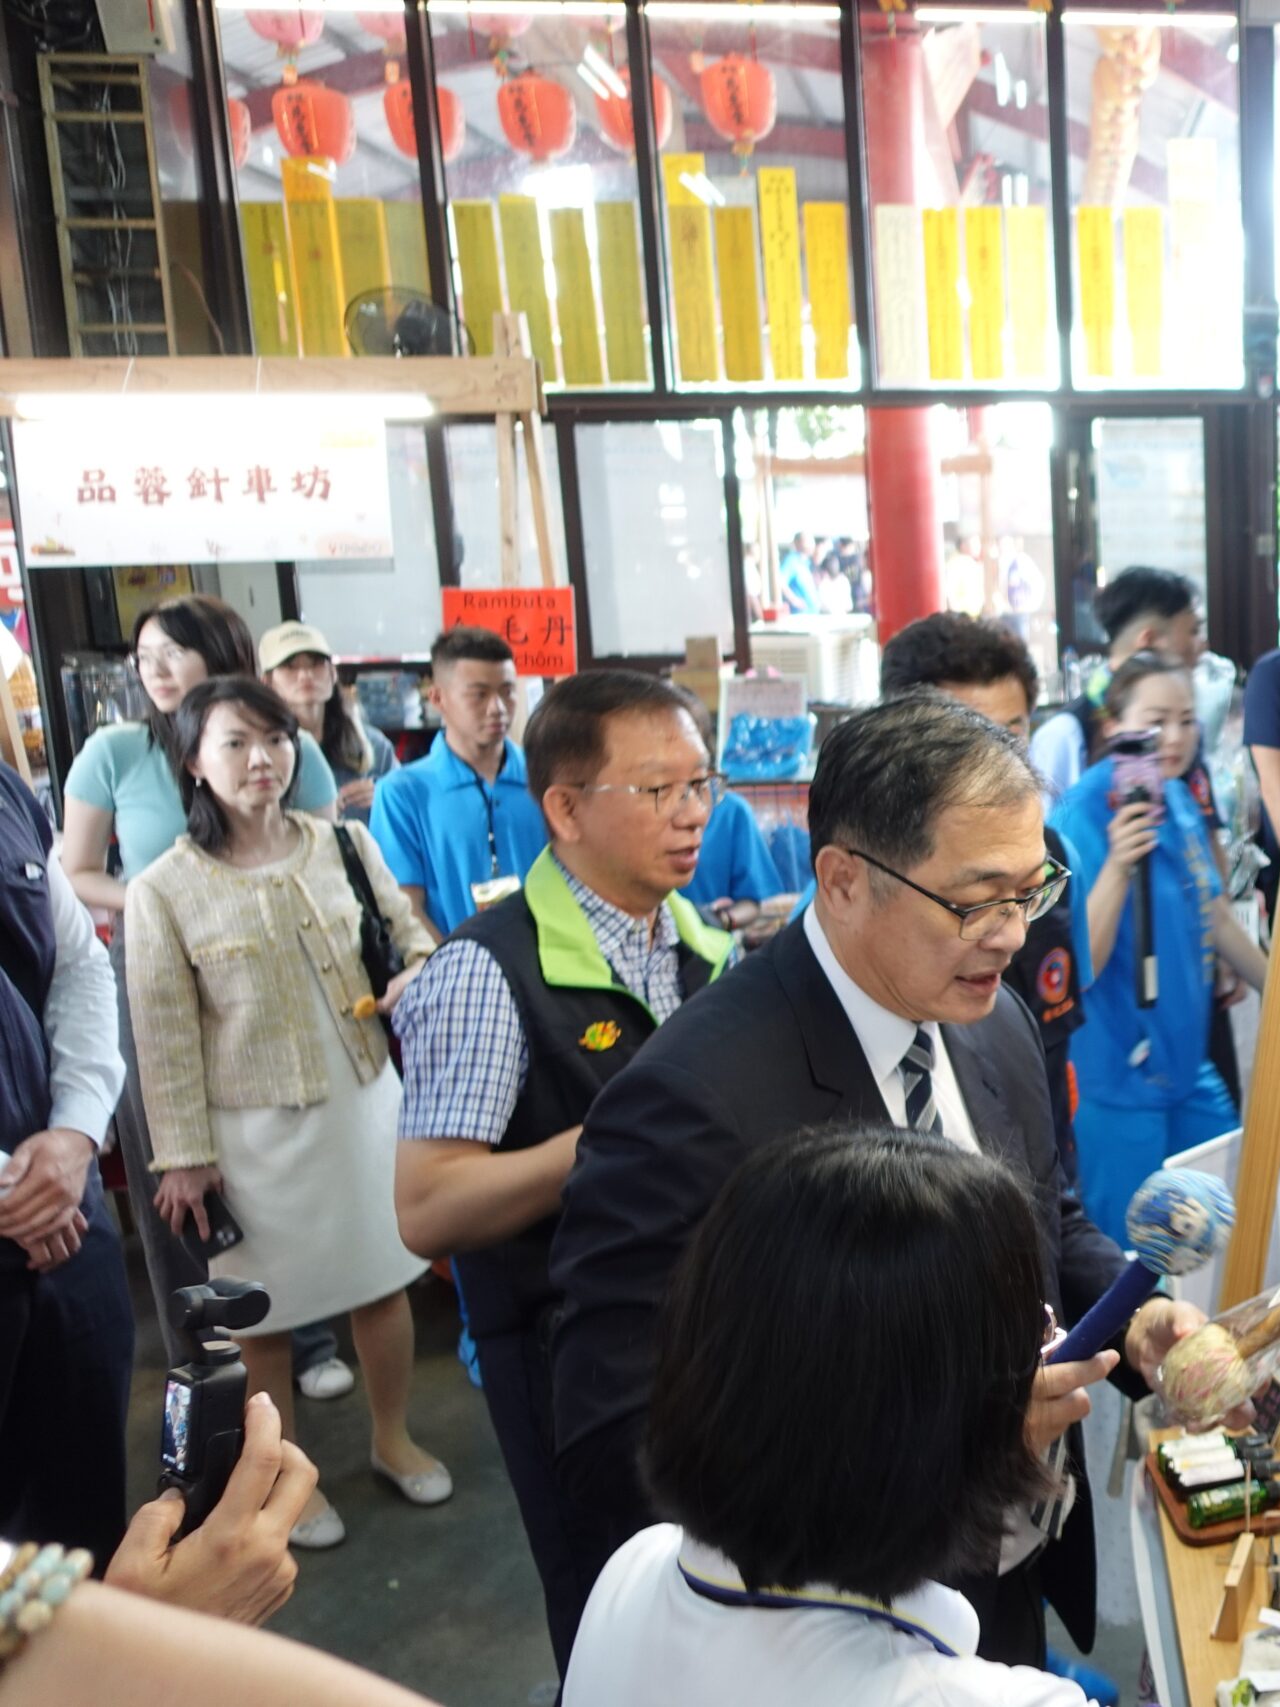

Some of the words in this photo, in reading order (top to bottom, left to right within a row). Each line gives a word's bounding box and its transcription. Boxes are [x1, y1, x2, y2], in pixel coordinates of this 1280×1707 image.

[76, 464, 332, 507] 品蓉針車坊
[456, 614, 573, 647] 毛丹
